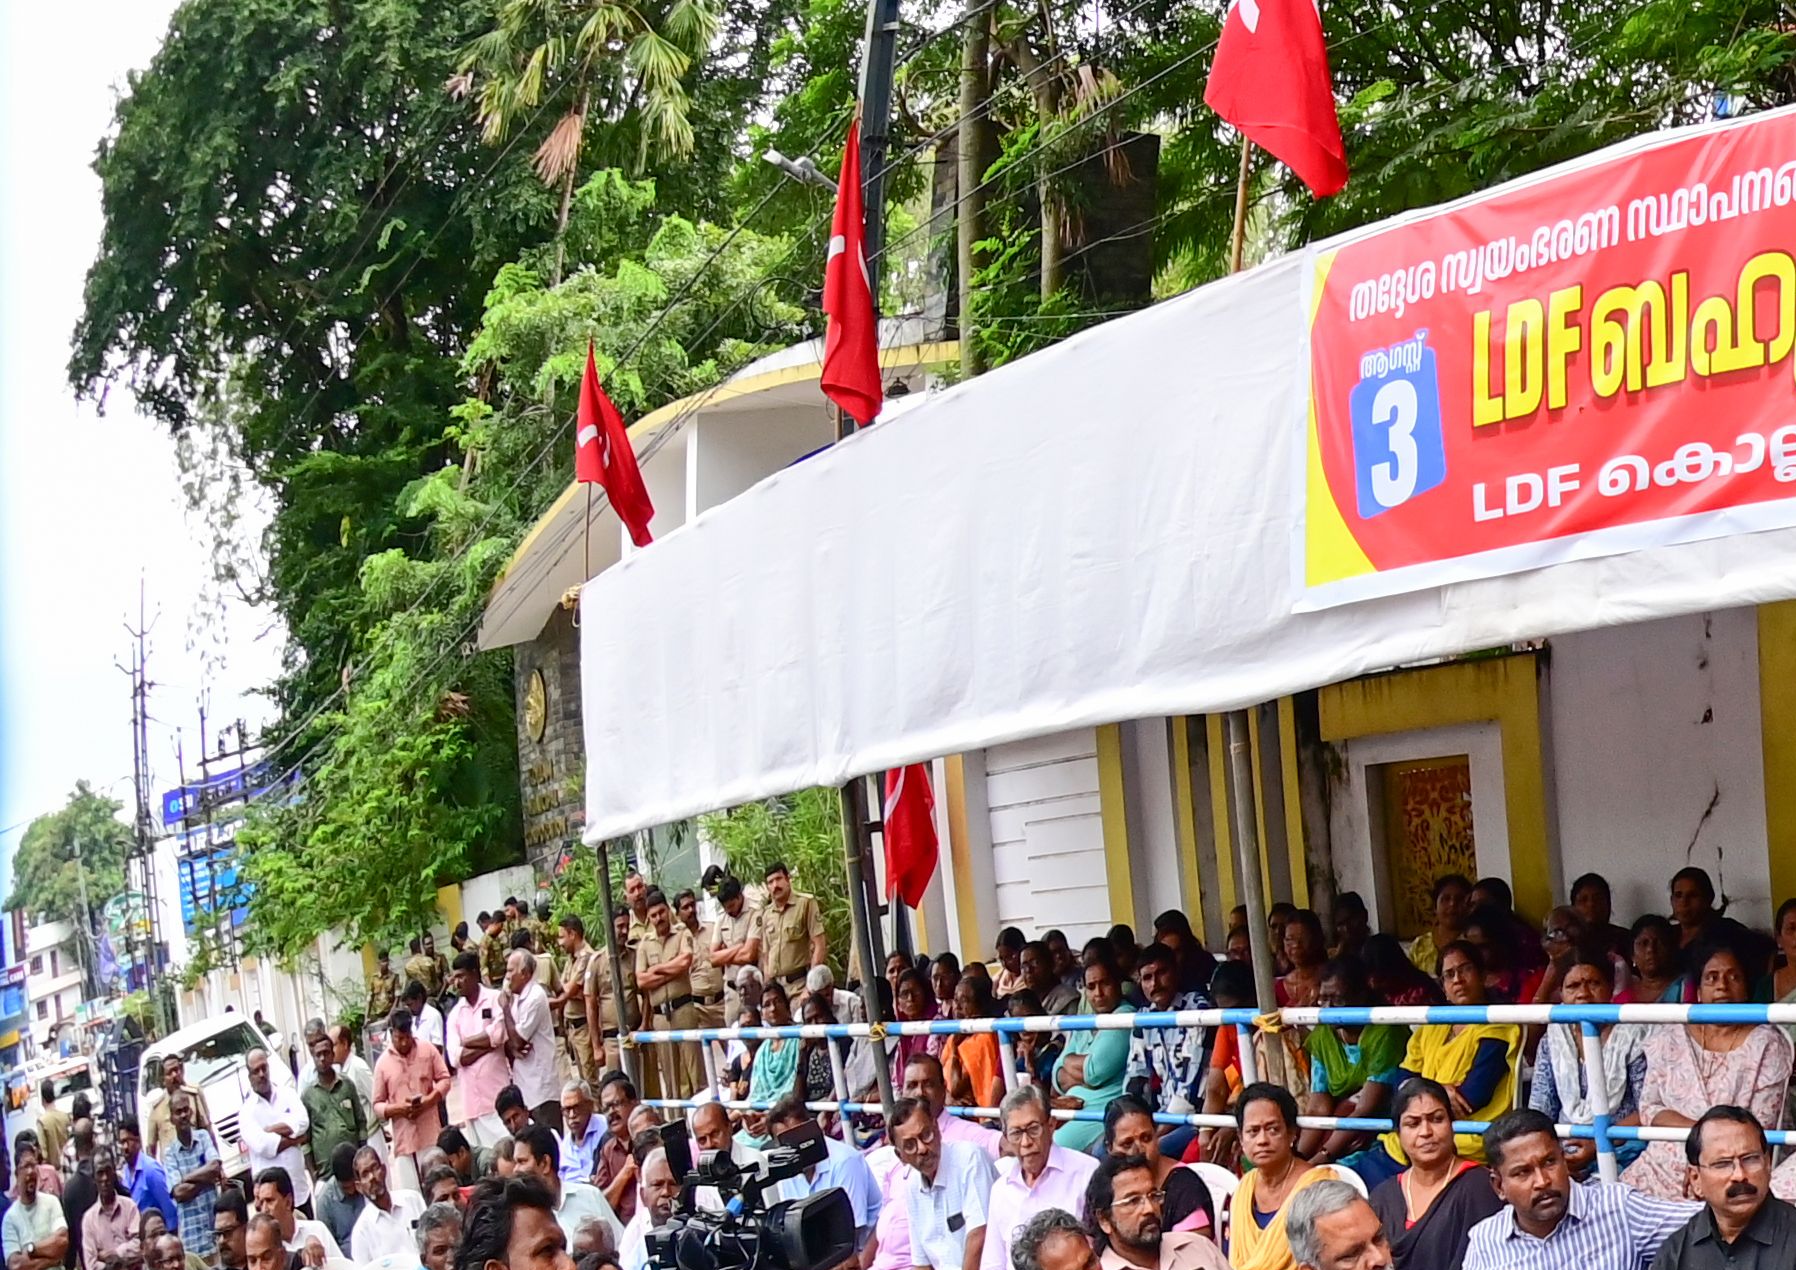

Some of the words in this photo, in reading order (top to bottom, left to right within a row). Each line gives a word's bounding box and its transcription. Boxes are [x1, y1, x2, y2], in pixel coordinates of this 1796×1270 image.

[1350, 260, 1435, 321] തദ്ദേശ
[1441, 205, 1619, 295] സ്വയംഭരണ
[1370, 380, 1419, 507] 3
[1472, 463, 1580, 522] LDF
